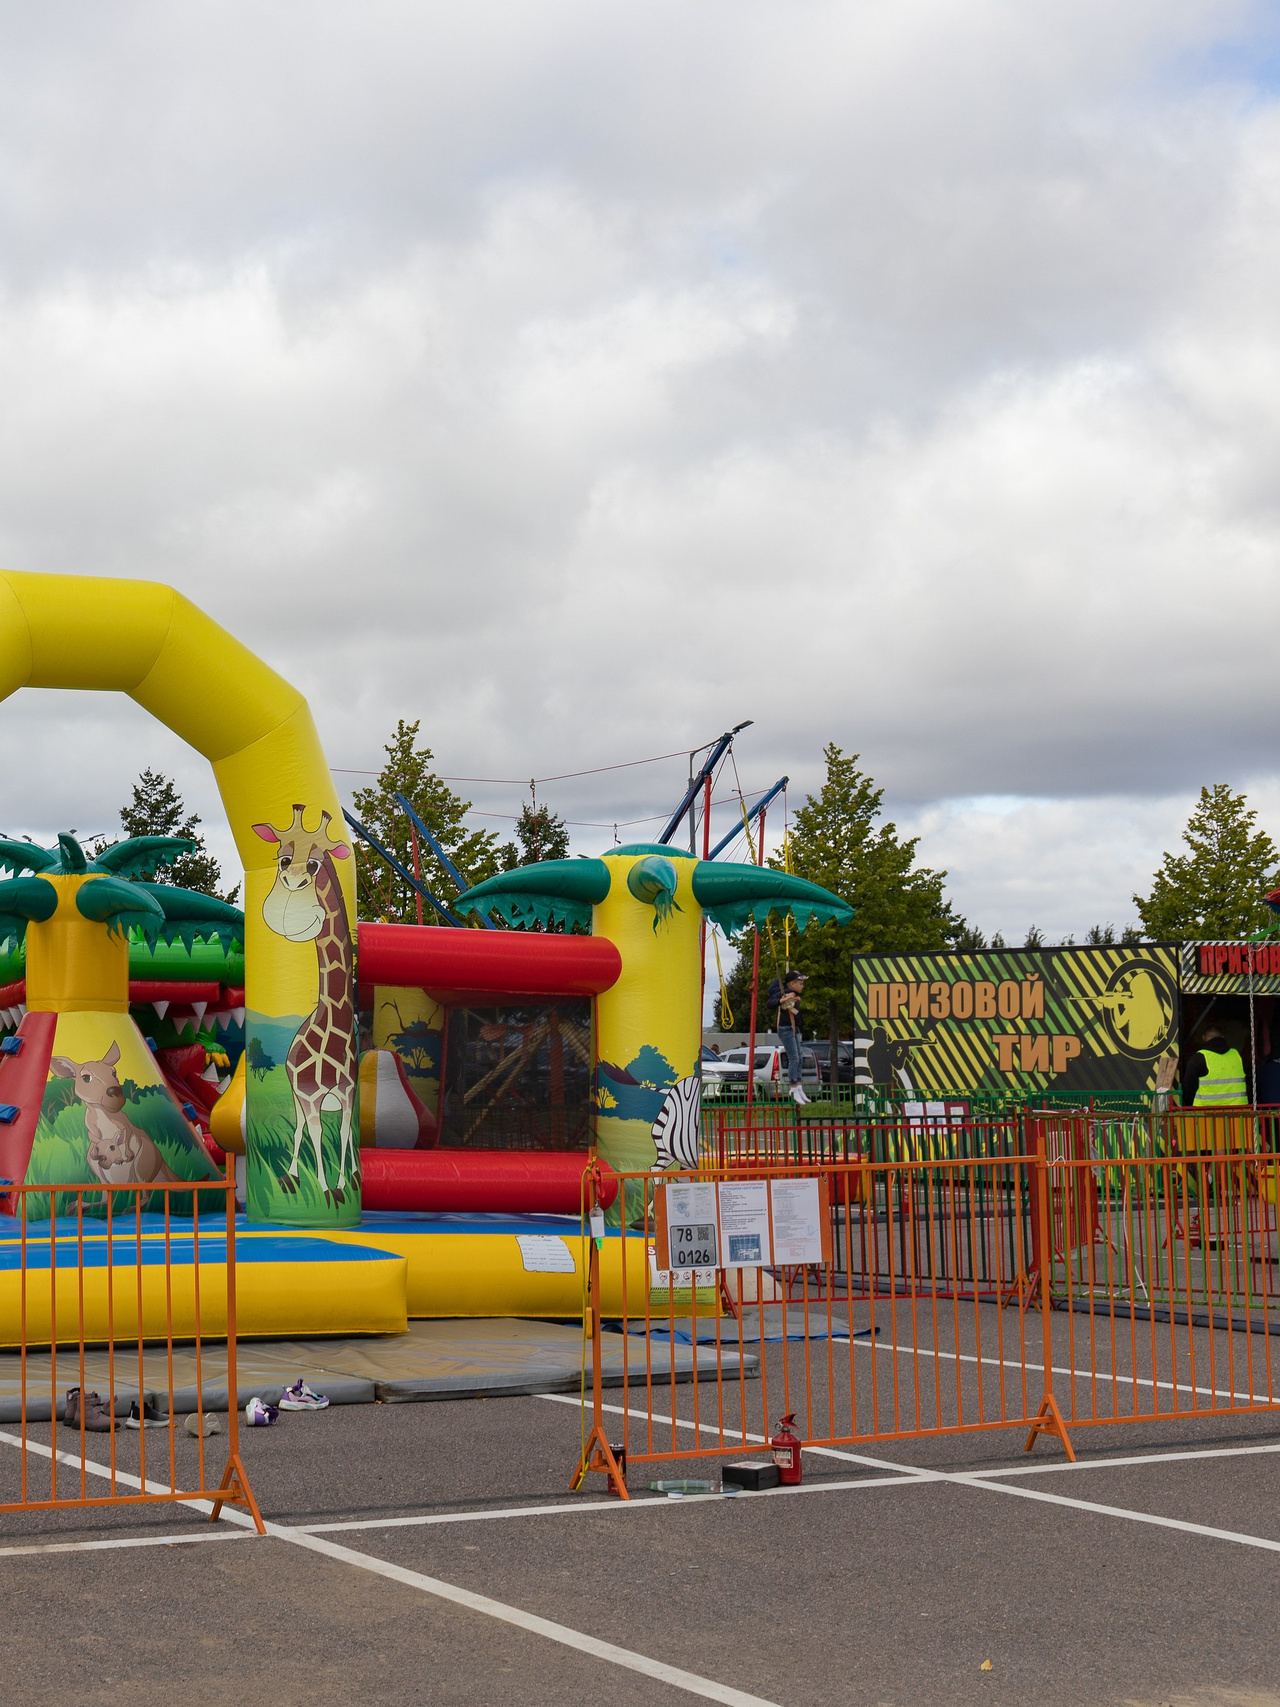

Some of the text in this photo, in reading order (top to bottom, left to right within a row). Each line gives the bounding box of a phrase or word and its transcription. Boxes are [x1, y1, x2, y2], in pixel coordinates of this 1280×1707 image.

[868, 973, 1044, 1020] ПРИЗОВОЙ
[992, 1034, 1081, 1073] ТИР
[676, 1227, 693, 1243] 78
[678, 1249, 710, 1265] 0126
